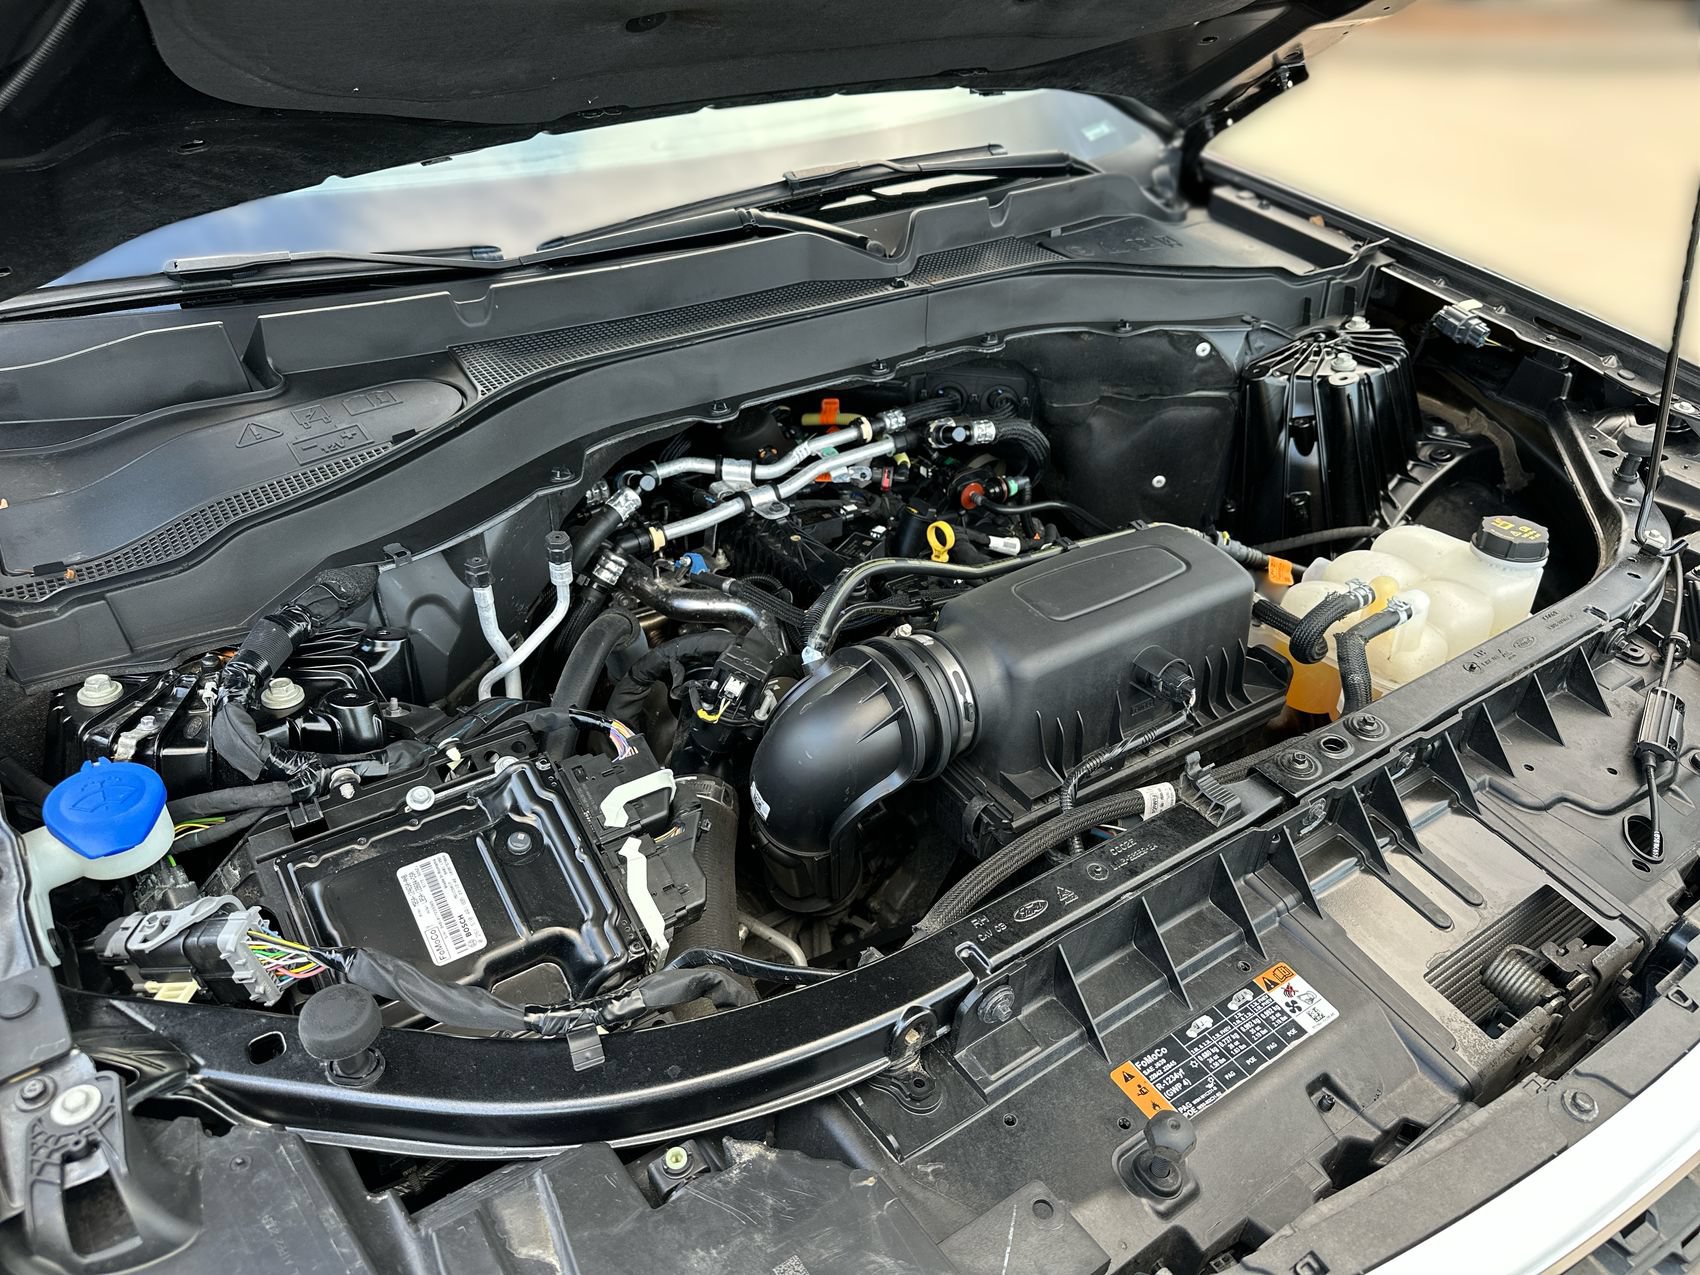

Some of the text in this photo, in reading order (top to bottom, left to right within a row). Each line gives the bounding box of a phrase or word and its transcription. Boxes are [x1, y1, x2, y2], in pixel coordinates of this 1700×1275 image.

[457, 914, 472, 937] BOSCH
[430, 929, 446, 960] FoMoCo
[1286, 1027, 1298, 1037] POE
[1266, 1042, 1277, 1051] PAG
[1134, 1047, 1167, 1070] FoMoCo
[1245, 1055, 1257, 1065] POE
[1142, 1065, 1155, 1076] SAE
[1224, 1070, 1236, 1080] PAG
[1155, 1068, 1185, 1090] R-1234yf
[1163, 1078, 1192, 1099] (GWP 4)
[1177, 1101, 1192, 1114] PAG
[1182, 1106, 1198, 1119] POE
